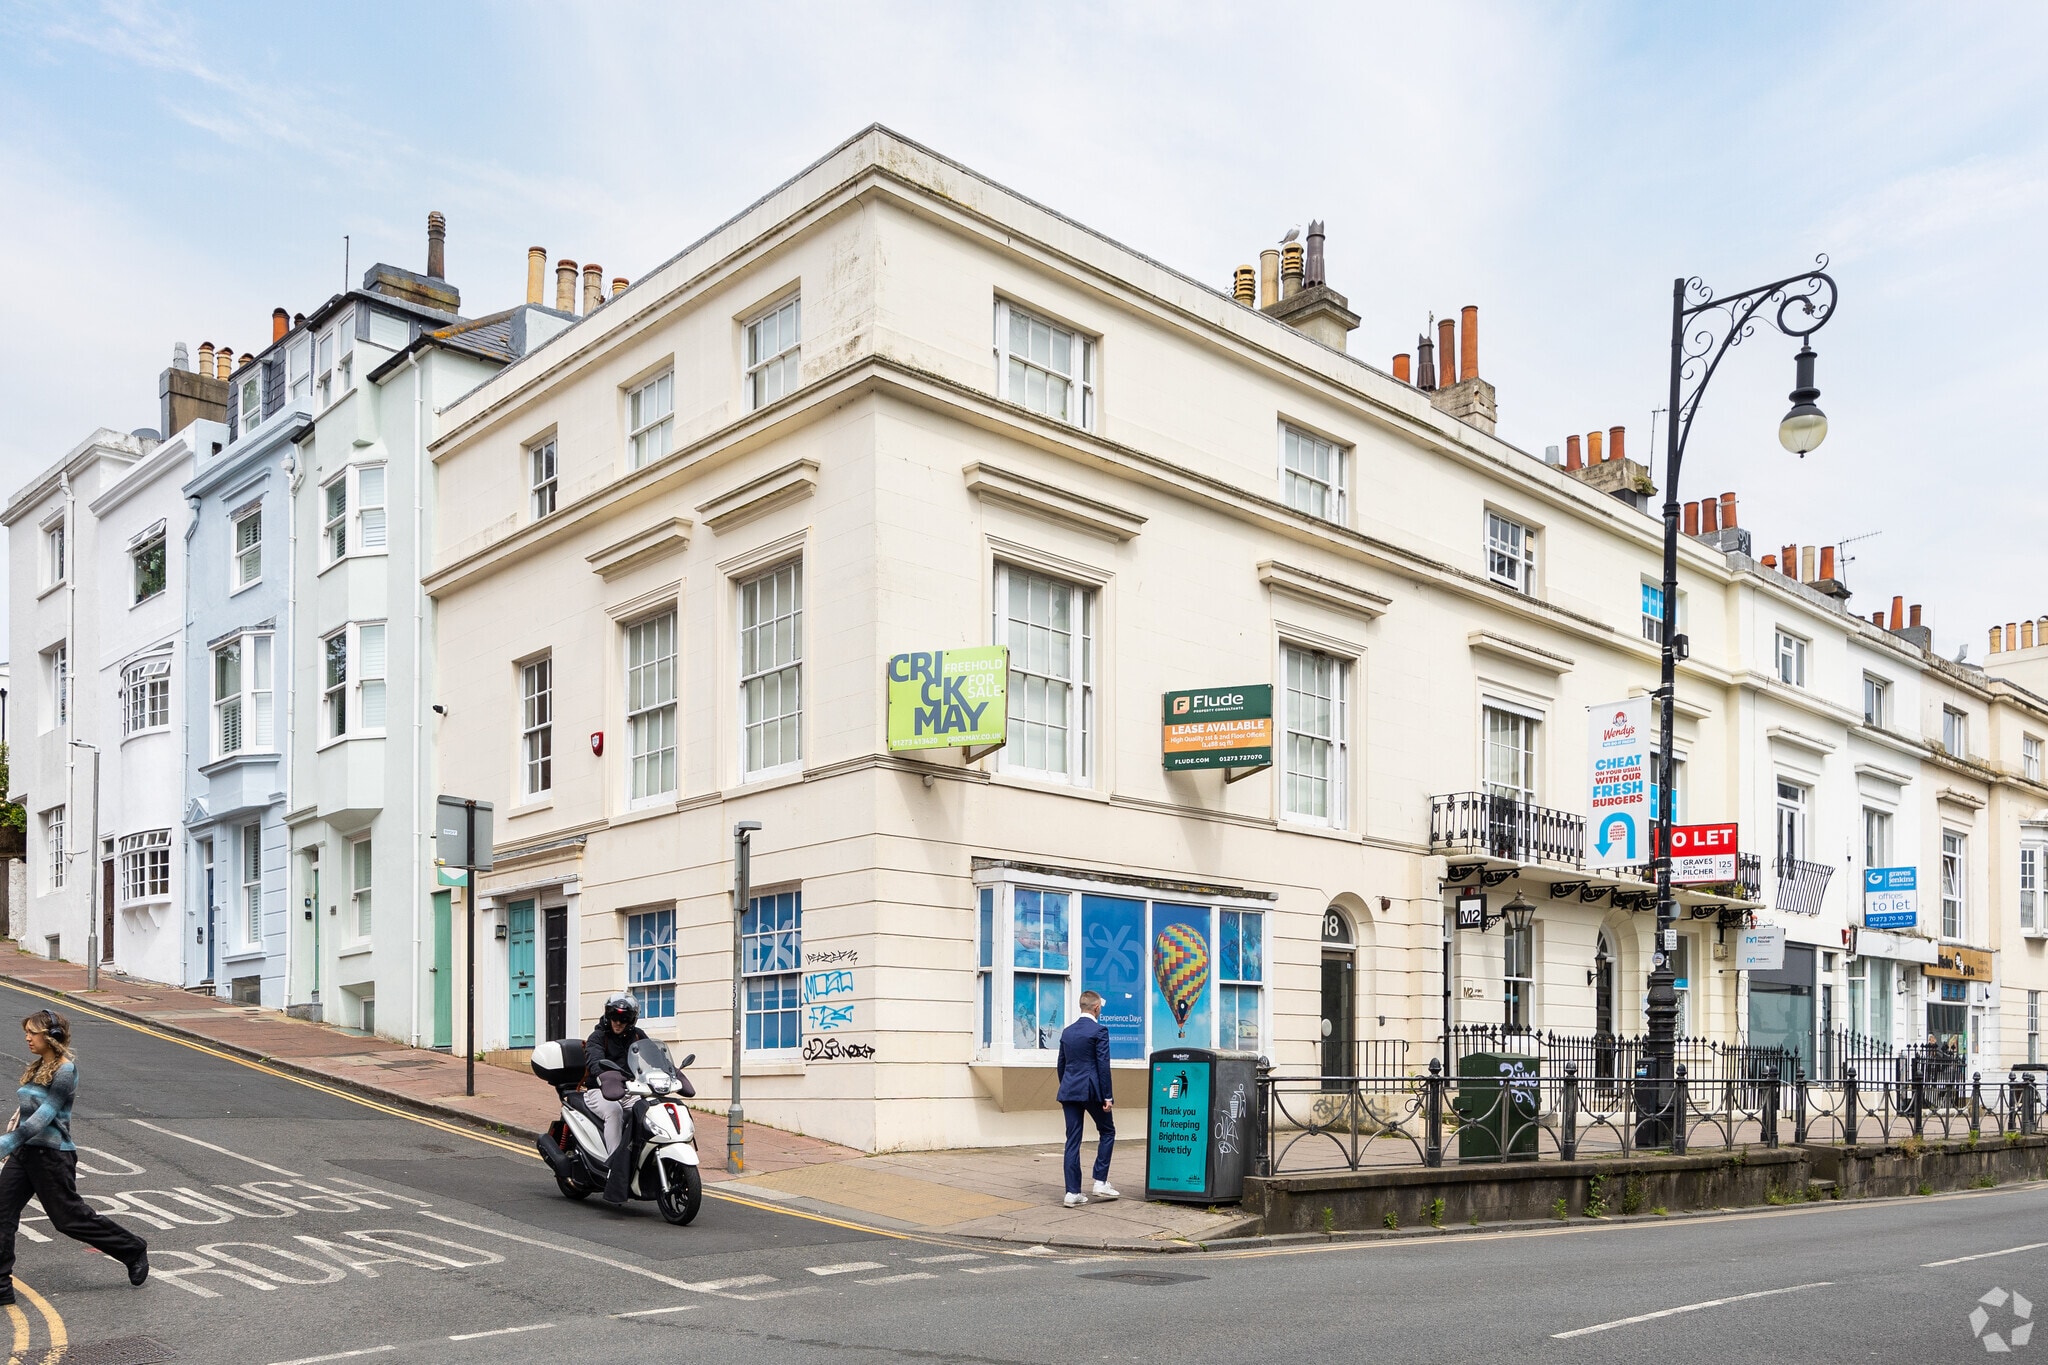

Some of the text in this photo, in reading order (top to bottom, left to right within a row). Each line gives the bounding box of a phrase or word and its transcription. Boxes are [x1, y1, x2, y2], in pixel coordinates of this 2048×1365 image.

[889, 651, 943, 686] CRI
[944, 659, 1003, 673] FREEHOLD
[968, 673, 995, 686] FOR
[921, 675, 967, 707] CK
[968, 685, 1001, 699] SALE
[1193, 693, 1244, 708] Flude
[914, 702, 989, 736] MAY
[1171, 720, 1264, 735] LEASE AVAILABLE
[1603, 724, 1635, 741] Wendy's
[892, 739, 912, 747] 01273
[1184, 735, 1204, 743] Quality
[1175, 757, 1209, 765] FLUDE.COM
[1595, 754, 1642, 770] CHEAT
[1595, 773, 1641, 784] WITH OUR
[1593, 780, 1643, 798] FRESH
[1593, 794, 1643, 807] BURGERS
[1671, 829, 1733, 847] O LET
[1889, 876, 1914, 884] jenkins
[1872, 899, 1910, 911] to let
[1461, 910, 1480, 923] M2
[1323, 915, 1339, 936] 18
[1463, 987, 1473, 998] M2
[1100, 1014, 1142, 1023] Experience Days
[1160, 1106, 1196, 1117] Thank you
[1159, 1119, 1200, 1131] for keeping
[1159, 1132, 1197, 1143] Brighton &
[1158, 1145, 1192, 1157] Hove tidy
[104, 1229, 505, 1298] ROAD
